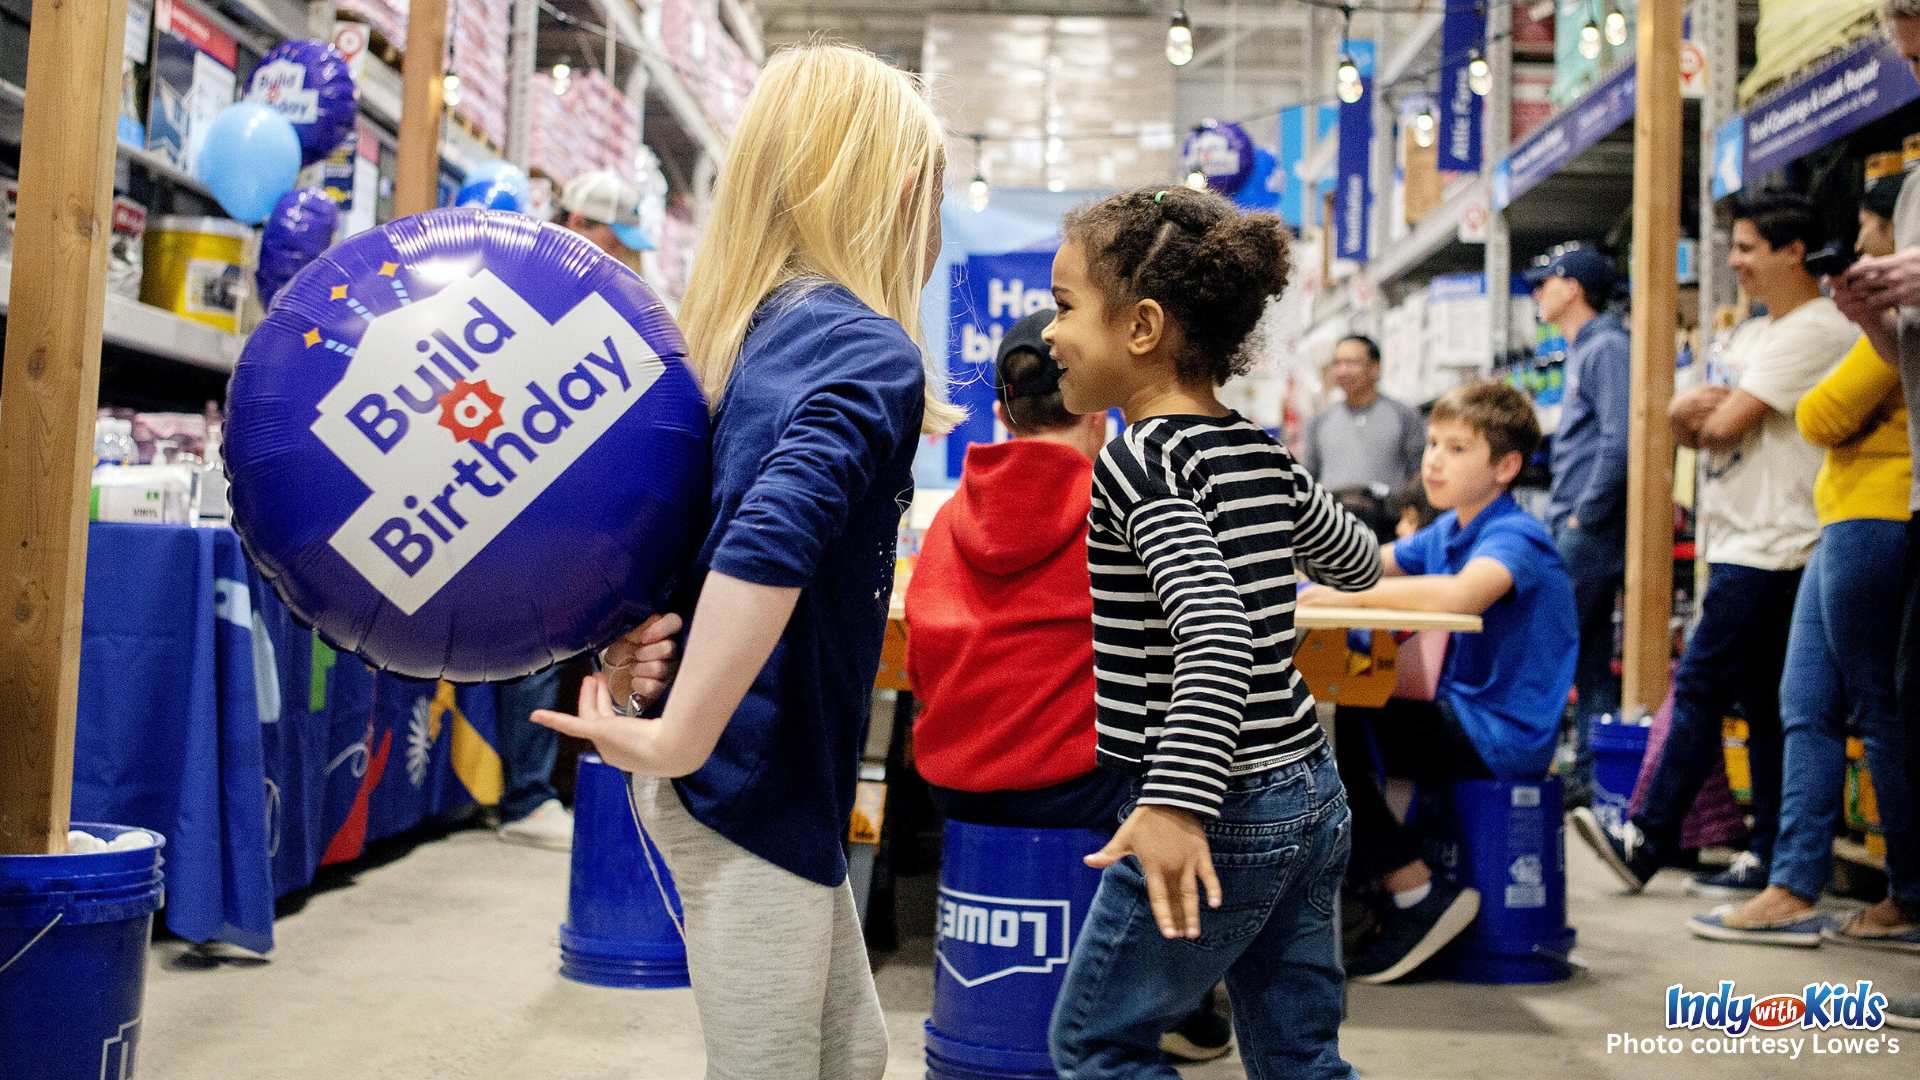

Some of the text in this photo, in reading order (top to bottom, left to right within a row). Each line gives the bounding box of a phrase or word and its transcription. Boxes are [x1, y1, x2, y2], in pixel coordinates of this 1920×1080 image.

[345, 297, 516, 455] Build
[453, 391, 492, 429] a
[369, 335, 632, 578] Birthday
